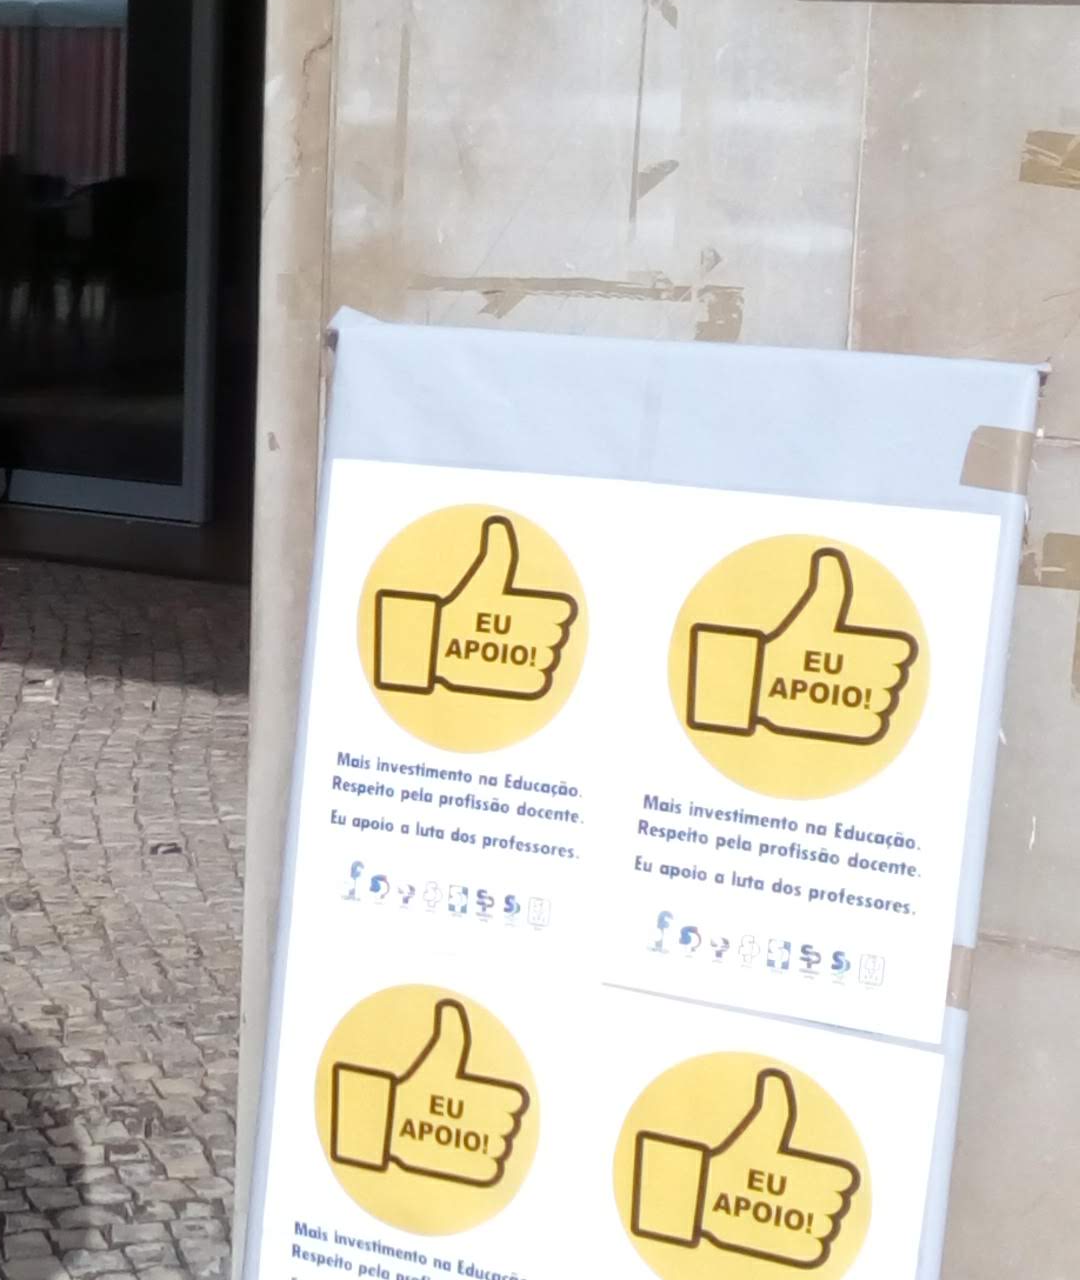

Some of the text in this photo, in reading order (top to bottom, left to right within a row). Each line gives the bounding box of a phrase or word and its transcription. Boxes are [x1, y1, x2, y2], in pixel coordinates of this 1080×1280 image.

[475, 612, 512, 635] EU
[444, 638, 538, 668] APOIO!
[803, 650, 845, 676] EU
[768, 677, 873, 711] APOIO!
[337, 751, 581, 797] Mais investimento na Educação.
[332, 775, 583, 823] Respeito pela profissão docente.
[330, 809, 578, 858] Eu apoio a luta dos professores.
[643, 794, 920, 849] Mais investimento na Educação.
[637, 819, 920, 877] Respeito pela profissão docente.
[634, 855, 915, 914] Eu apoio a luta dos professores.
[428, 1094, 465, 1120] EU
[398, 1118, 490, 1155] APOIO!
[746, 1168, 788, 1197] EU
[711, 1192, 815, 1235] APOIO!
[292, 1243, 352, 1270] Respeito
[358, 1263, 389, 1280] pela
[294, 1221, 328, 1241] Mais
[334, 1230, 427, 1265] investimento
[433, 1258, 451, 1271] na
